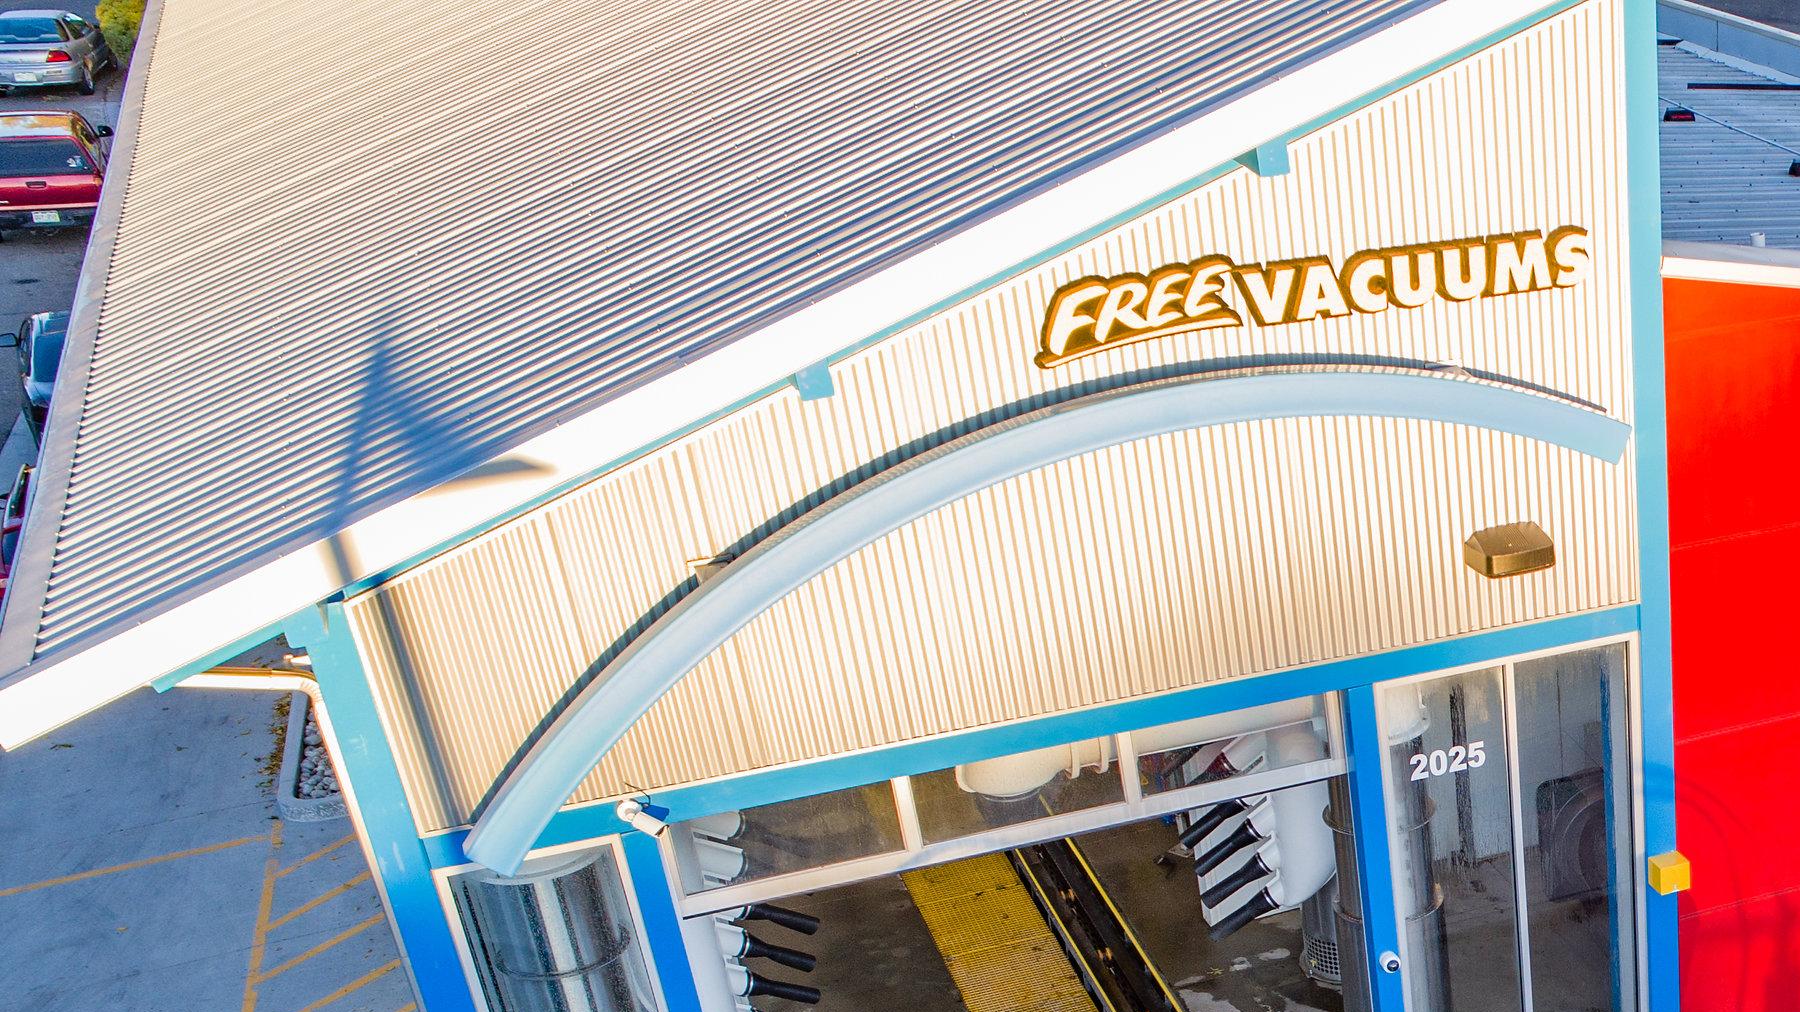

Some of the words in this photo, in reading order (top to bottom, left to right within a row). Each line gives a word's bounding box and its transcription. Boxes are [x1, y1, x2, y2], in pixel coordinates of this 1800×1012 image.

[1046, 258, 1238, 362] FREE
[1237, 227, 1589, 326] VACUUMS
[1409, 740, 1486, 782] 2025
